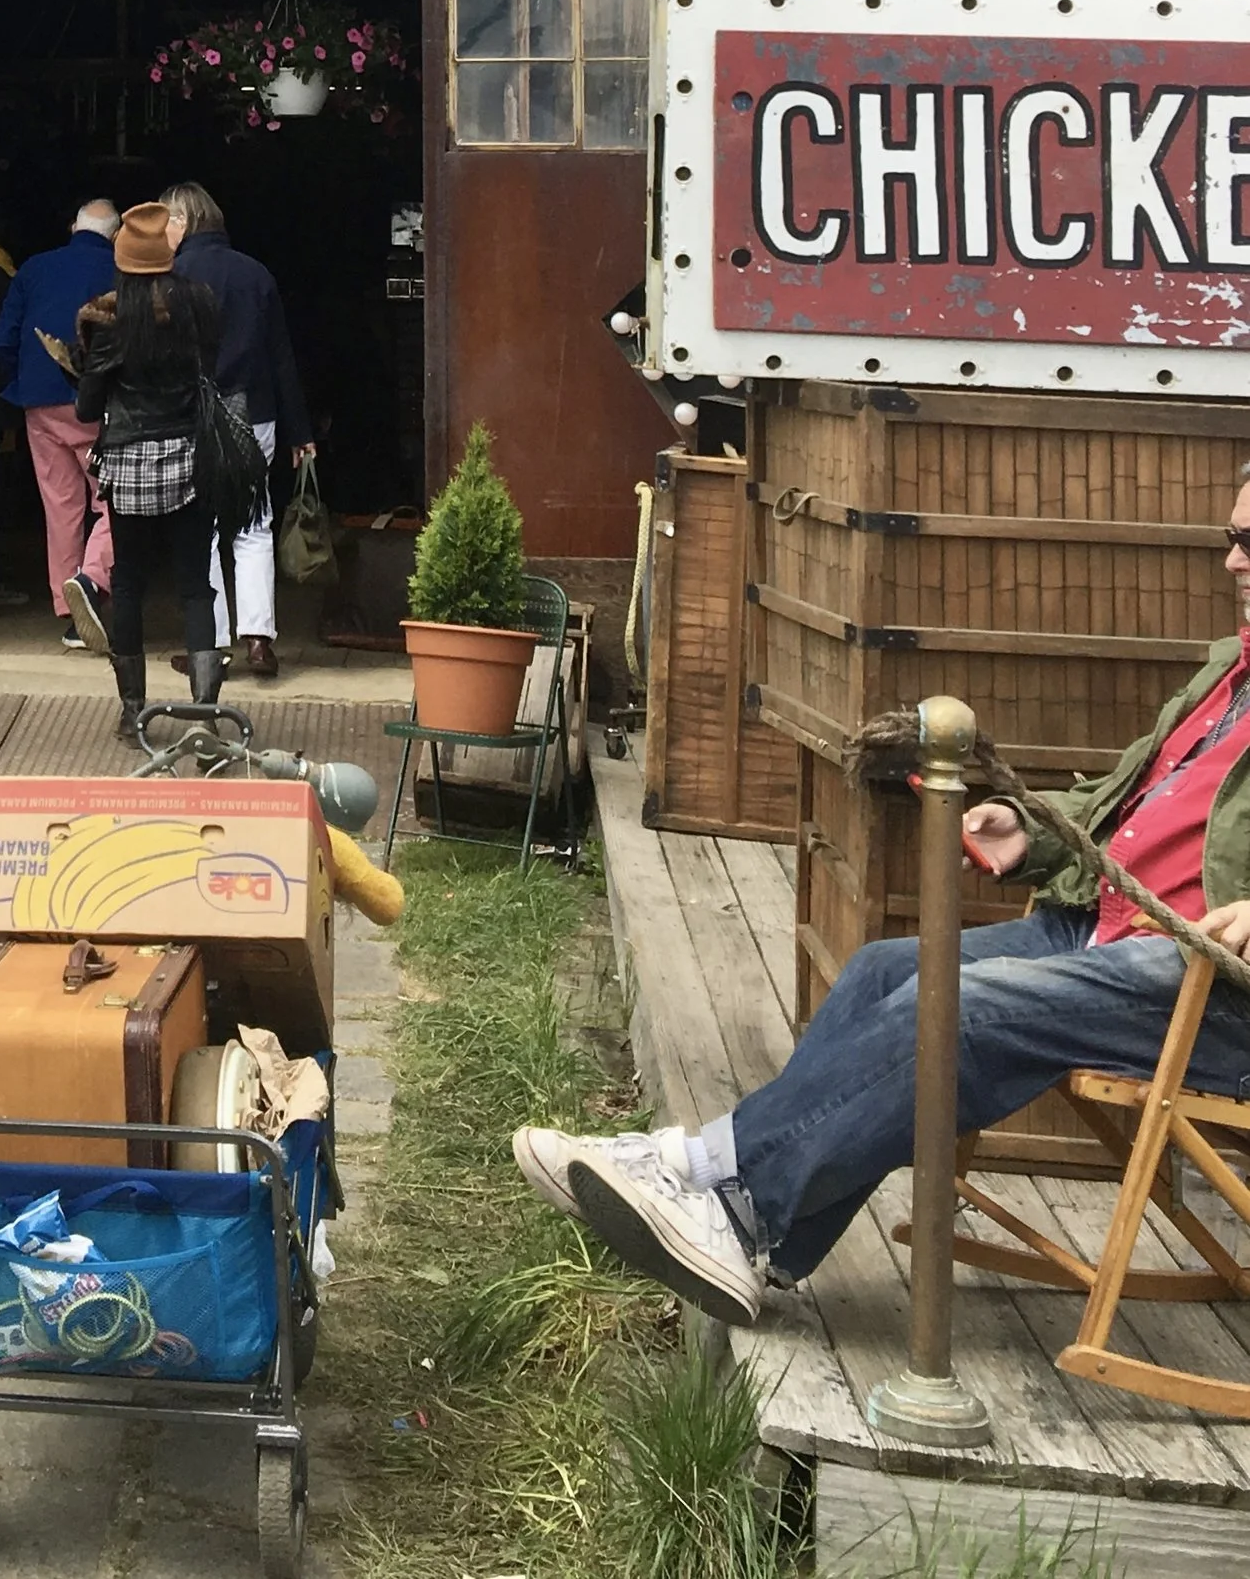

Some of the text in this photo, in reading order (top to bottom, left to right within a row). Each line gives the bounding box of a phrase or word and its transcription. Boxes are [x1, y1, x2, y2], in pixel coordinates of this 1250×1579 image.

[752, 81, 1250, 272] CHICKE
[29, 796, 77, 809] PREMIUM
[89, 797, 139, 809] BANANAS
[139, 798, 187, 810] PREMIUM
[200, 799, 250, 811] BANANAS
[251, 800, 299, 812] PREMIUM
[208, 874, 272, 902] Dole
